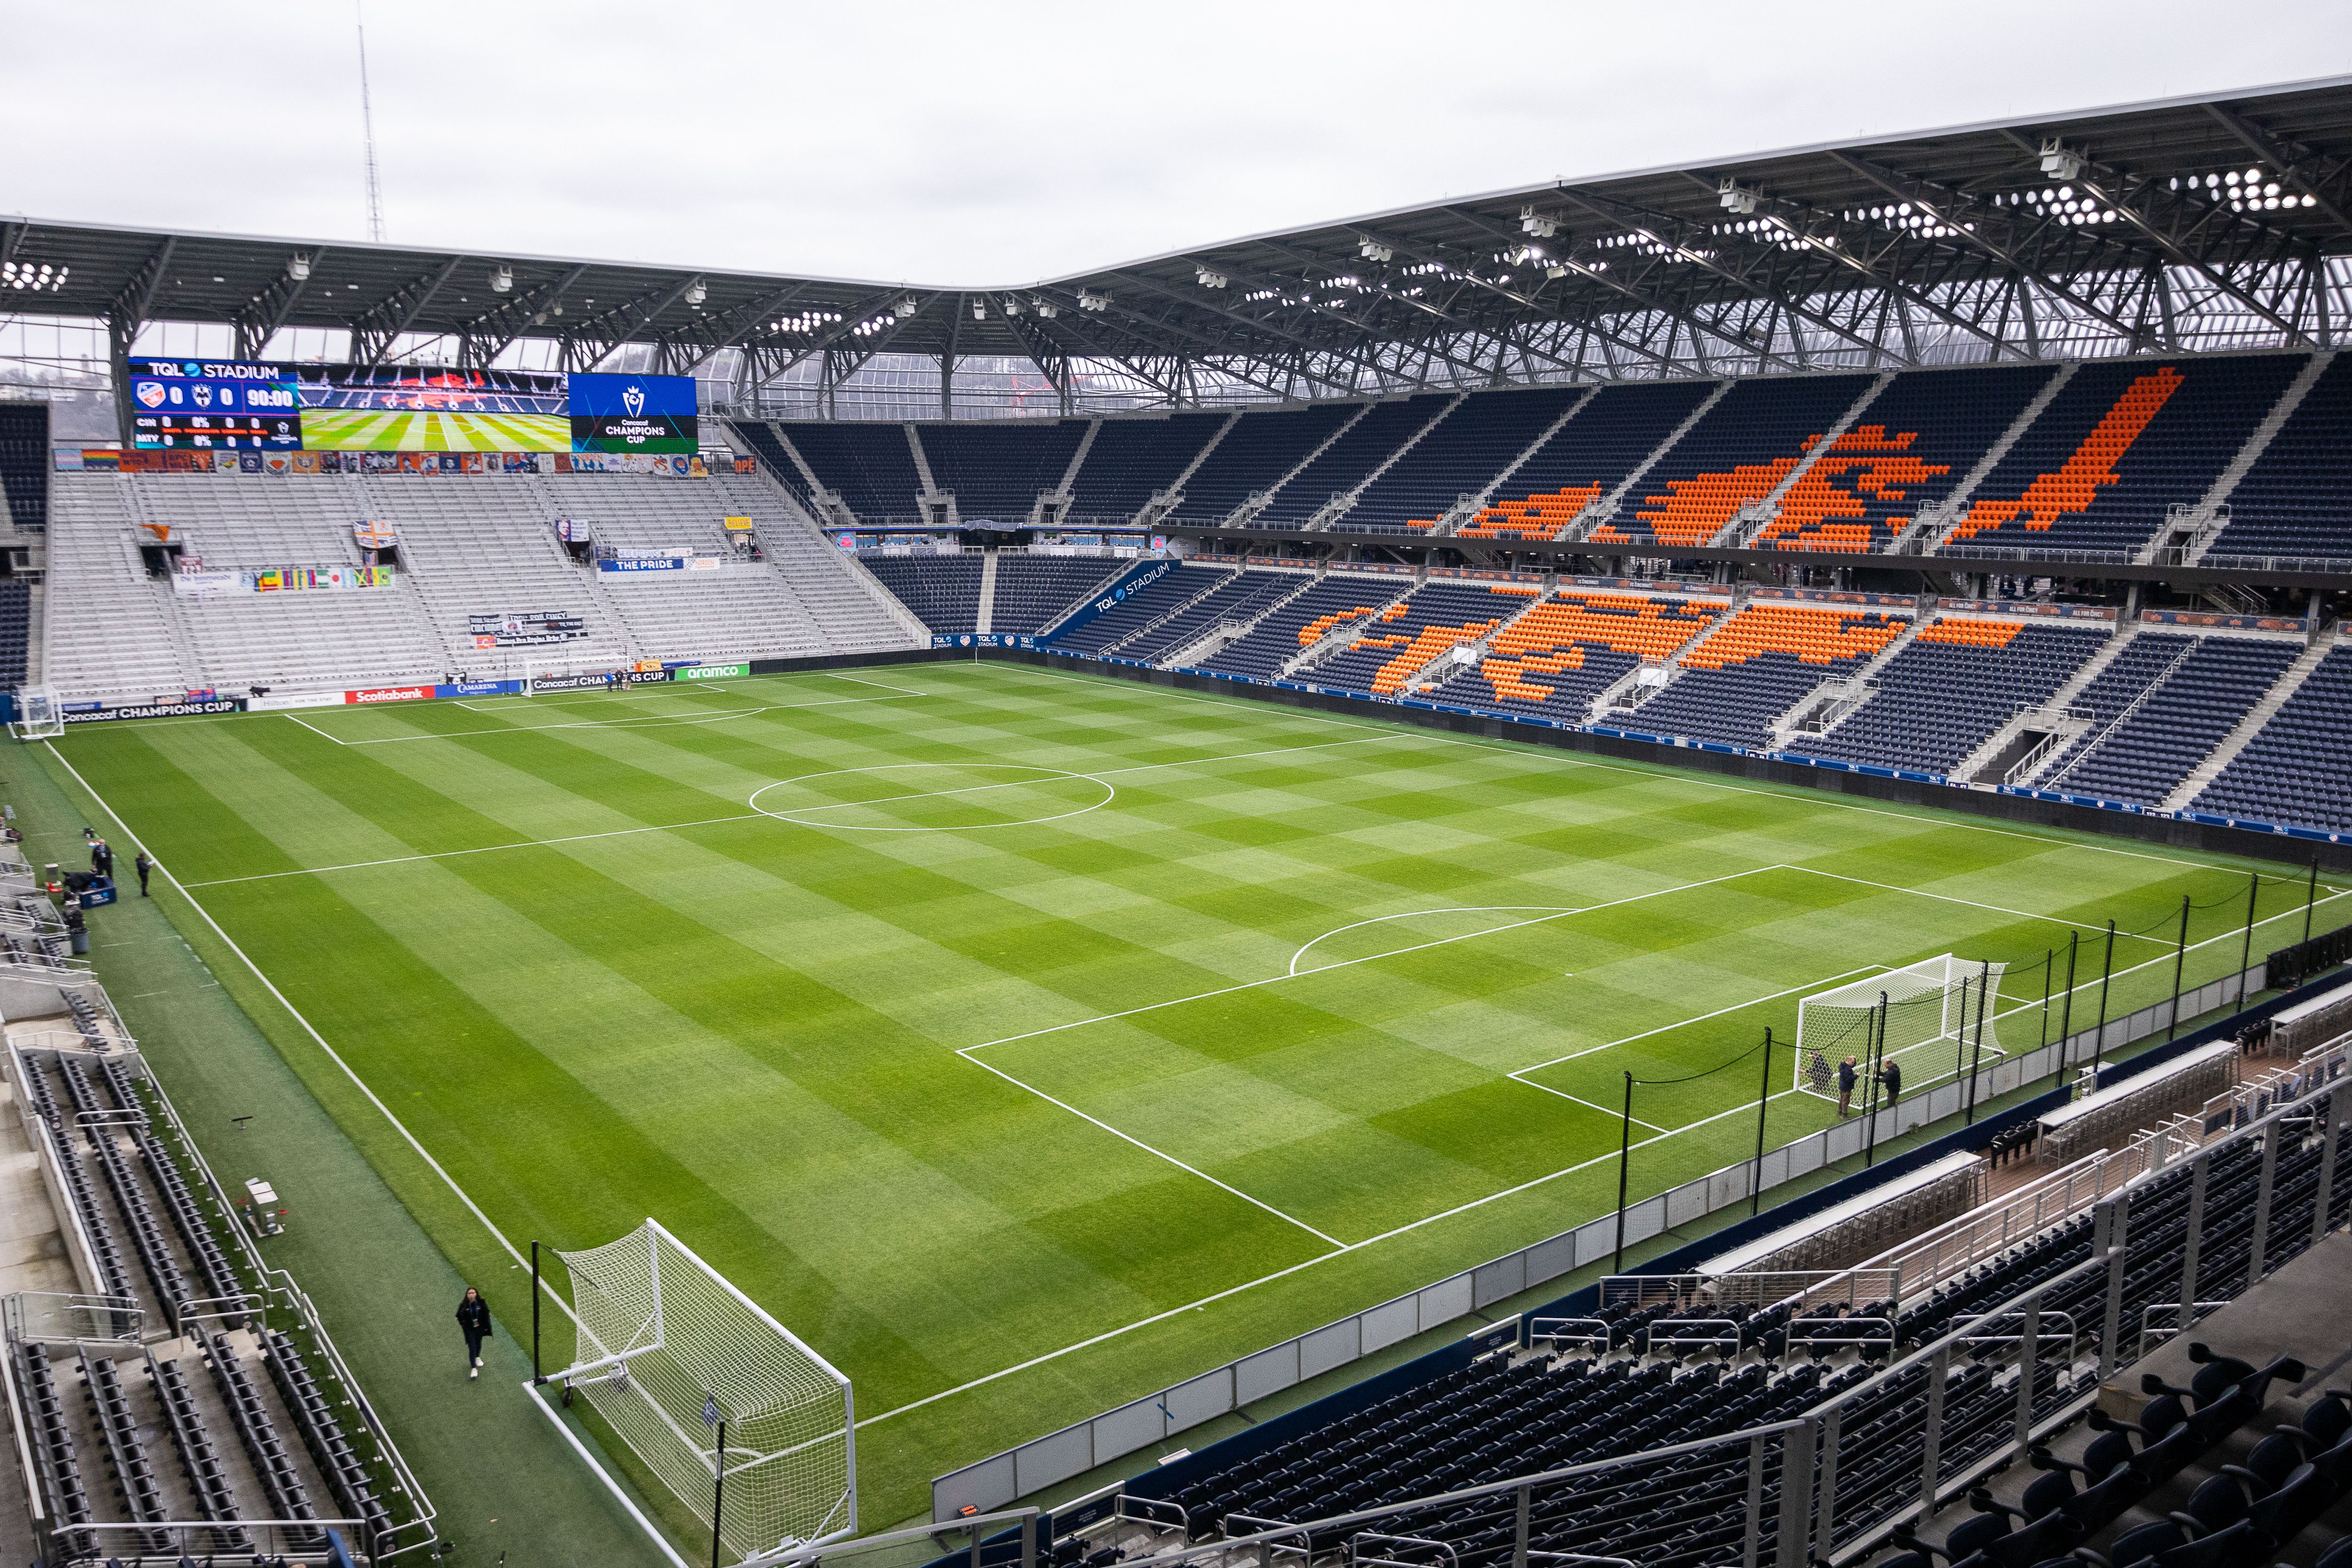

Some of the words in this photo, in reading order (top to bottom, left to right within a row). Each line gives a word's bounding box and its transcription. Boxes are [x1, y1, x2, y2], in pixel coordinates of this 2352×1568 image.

[148, 362, 185, 377] TQL
[204, 364, 279, 379] STADIUM
[169, 386, 183, 404] 0
[220, 388, 233, 406] 0
[247, 389, 293, 407] 90:00
[136, 418, 157, 427] CIN
[605, 426, 665, 436] CHAMPIONS
[616, 561, 638, 570] THE
[640, 560, 673, 569] PRIDE
[1095, 596, 1117, 613] TQL
[1126, 562, 1170, 595] STADIUM
[534, 677, 578, 689] Concacaf
[643, 672, 664, 681] CUP
[688, 666, 739, 678] aramco
[356, 688, 423, 702] Scotiabank
[457, 683, 498, 693] CAMARENA
[62, 709, 118, 722] Concacaf
[119, 703, 203, 719] CHAMPIONS
[204, 701, 233, 712] CUP
